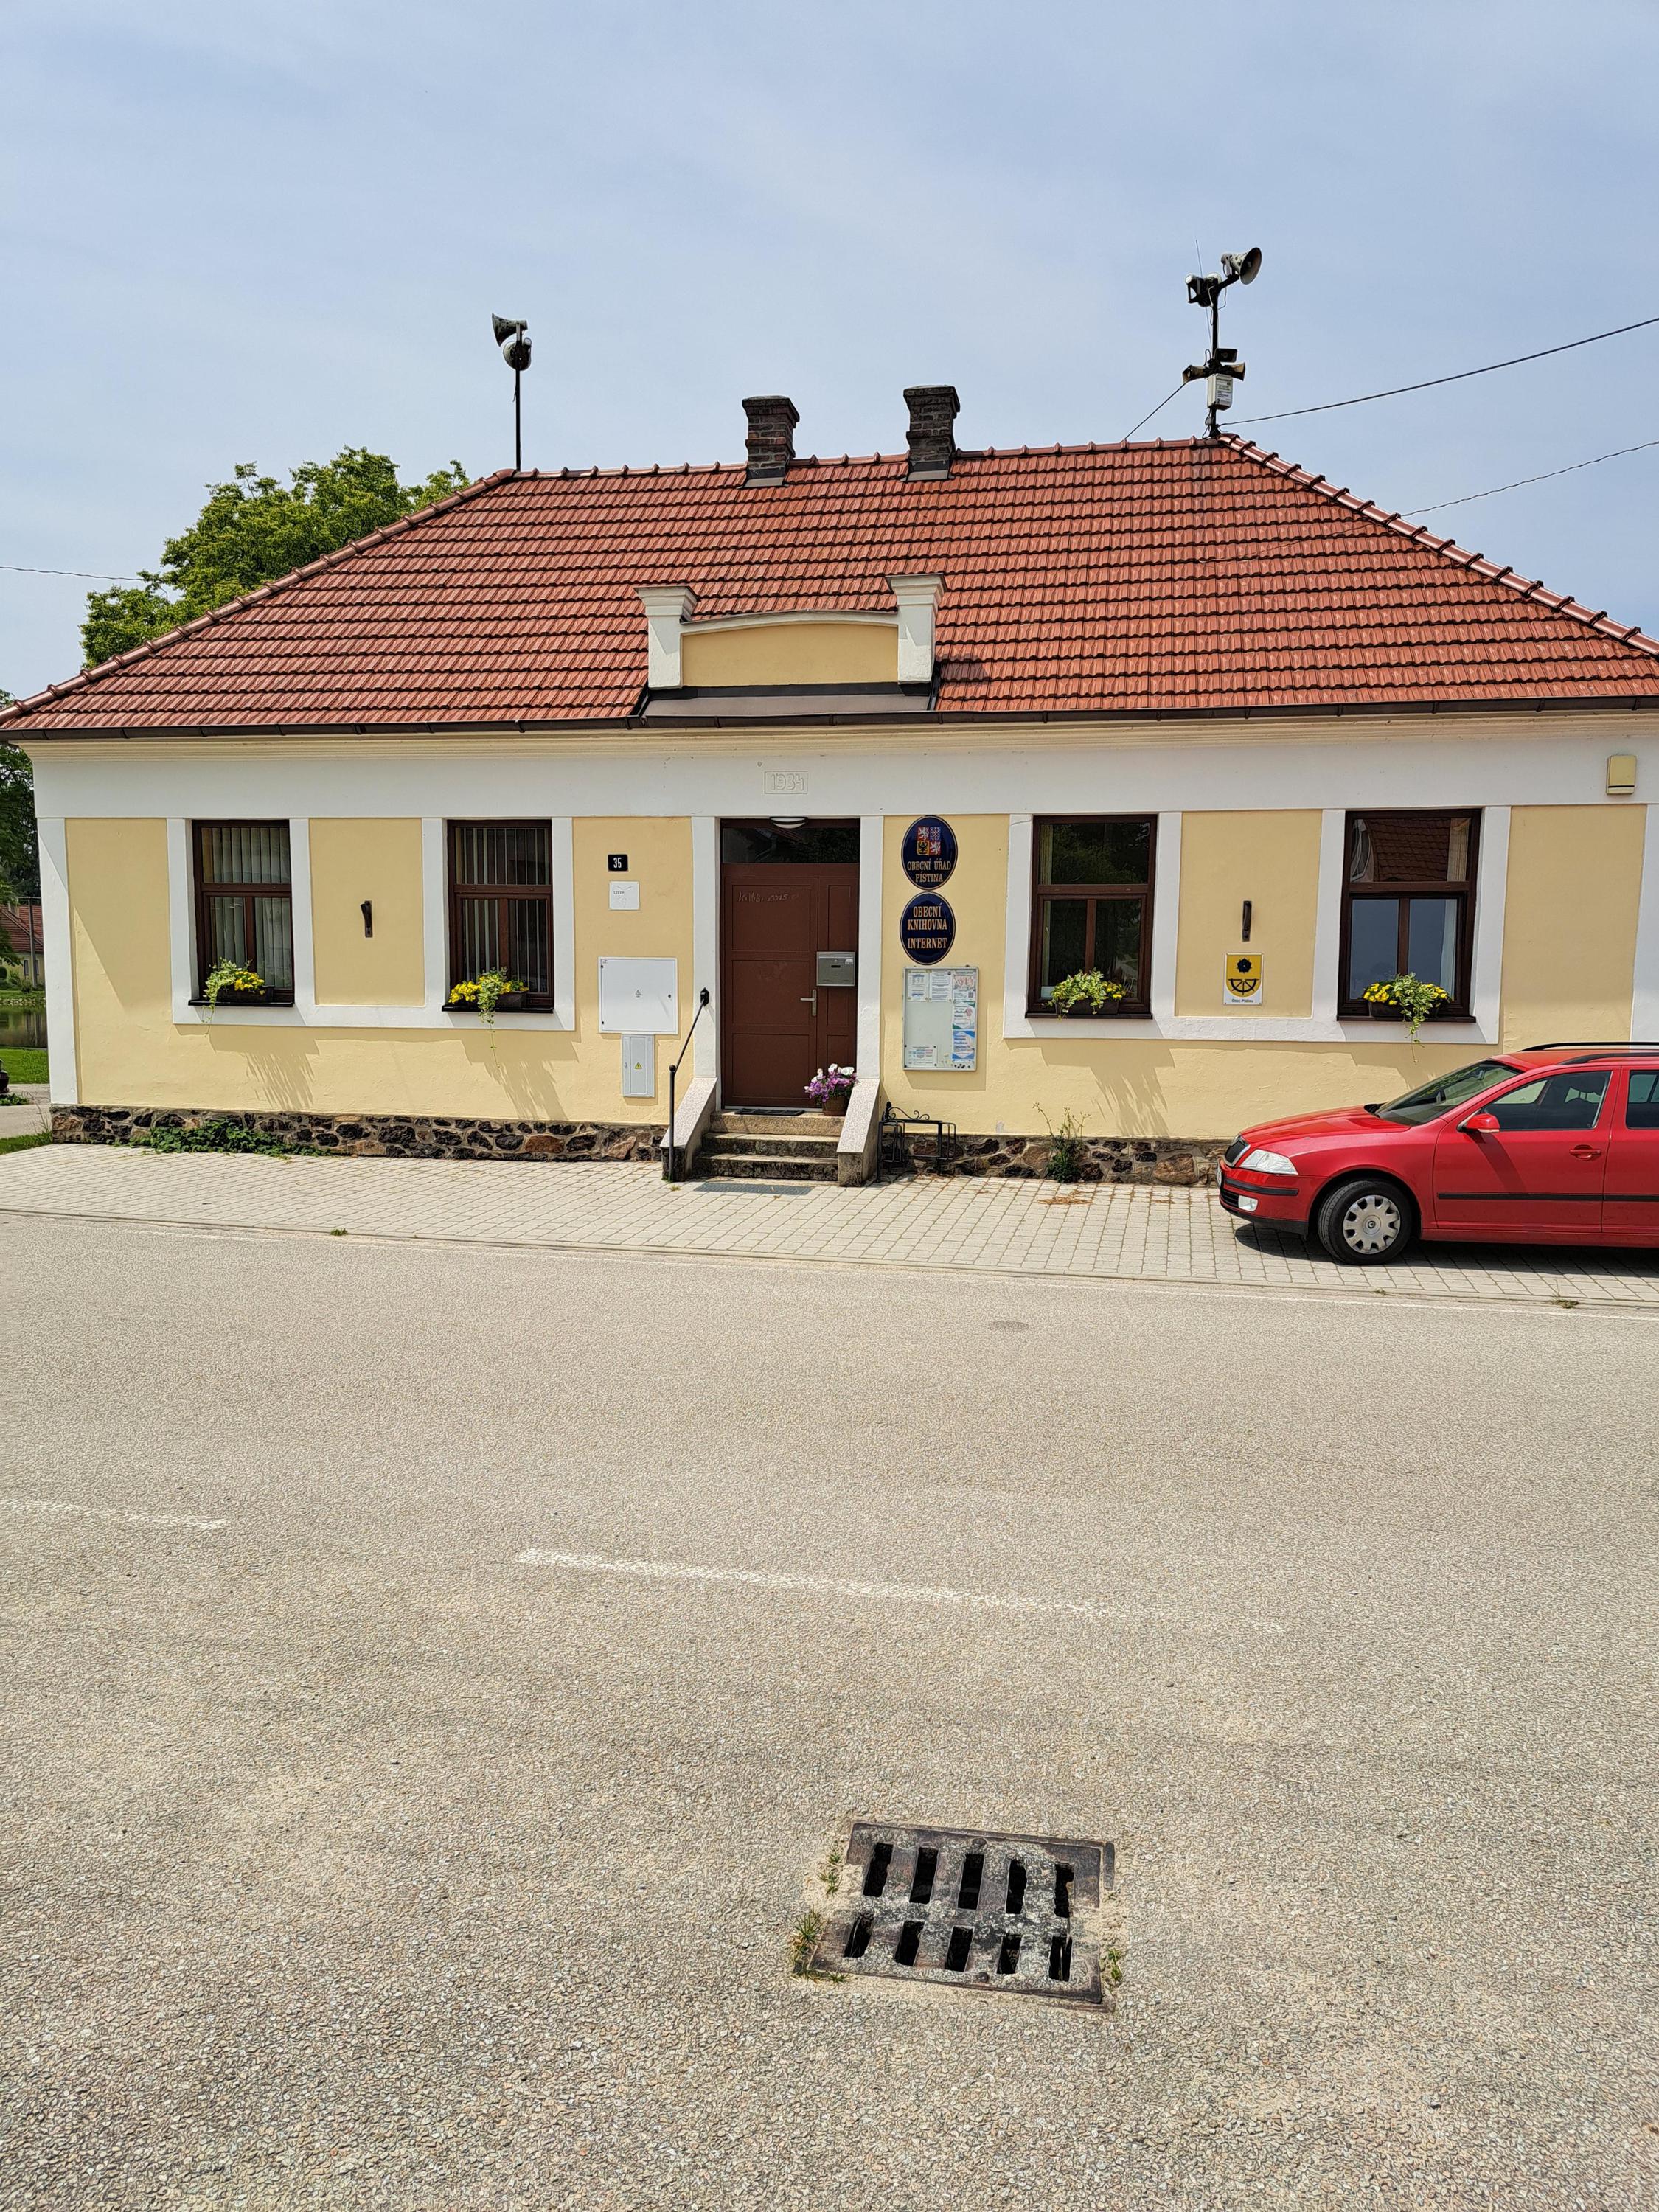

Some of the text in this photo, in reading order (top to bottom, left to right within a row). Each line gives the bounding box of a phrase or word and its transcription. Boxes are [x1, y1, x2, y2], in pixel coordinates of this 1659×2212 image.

[771, 773, 804, 791] 1934
[613, 857, 622, 868] 35
[907, 858, 951, 870] OBECNÍ ÚŘAD
[915, 870, 943, 883] PÍSTINA
[913, 902, 942, 917] OBECNÍ
[908, 919, 947, 931] KNIHOVNA
[908, 937, 947, 949] INTERNET
